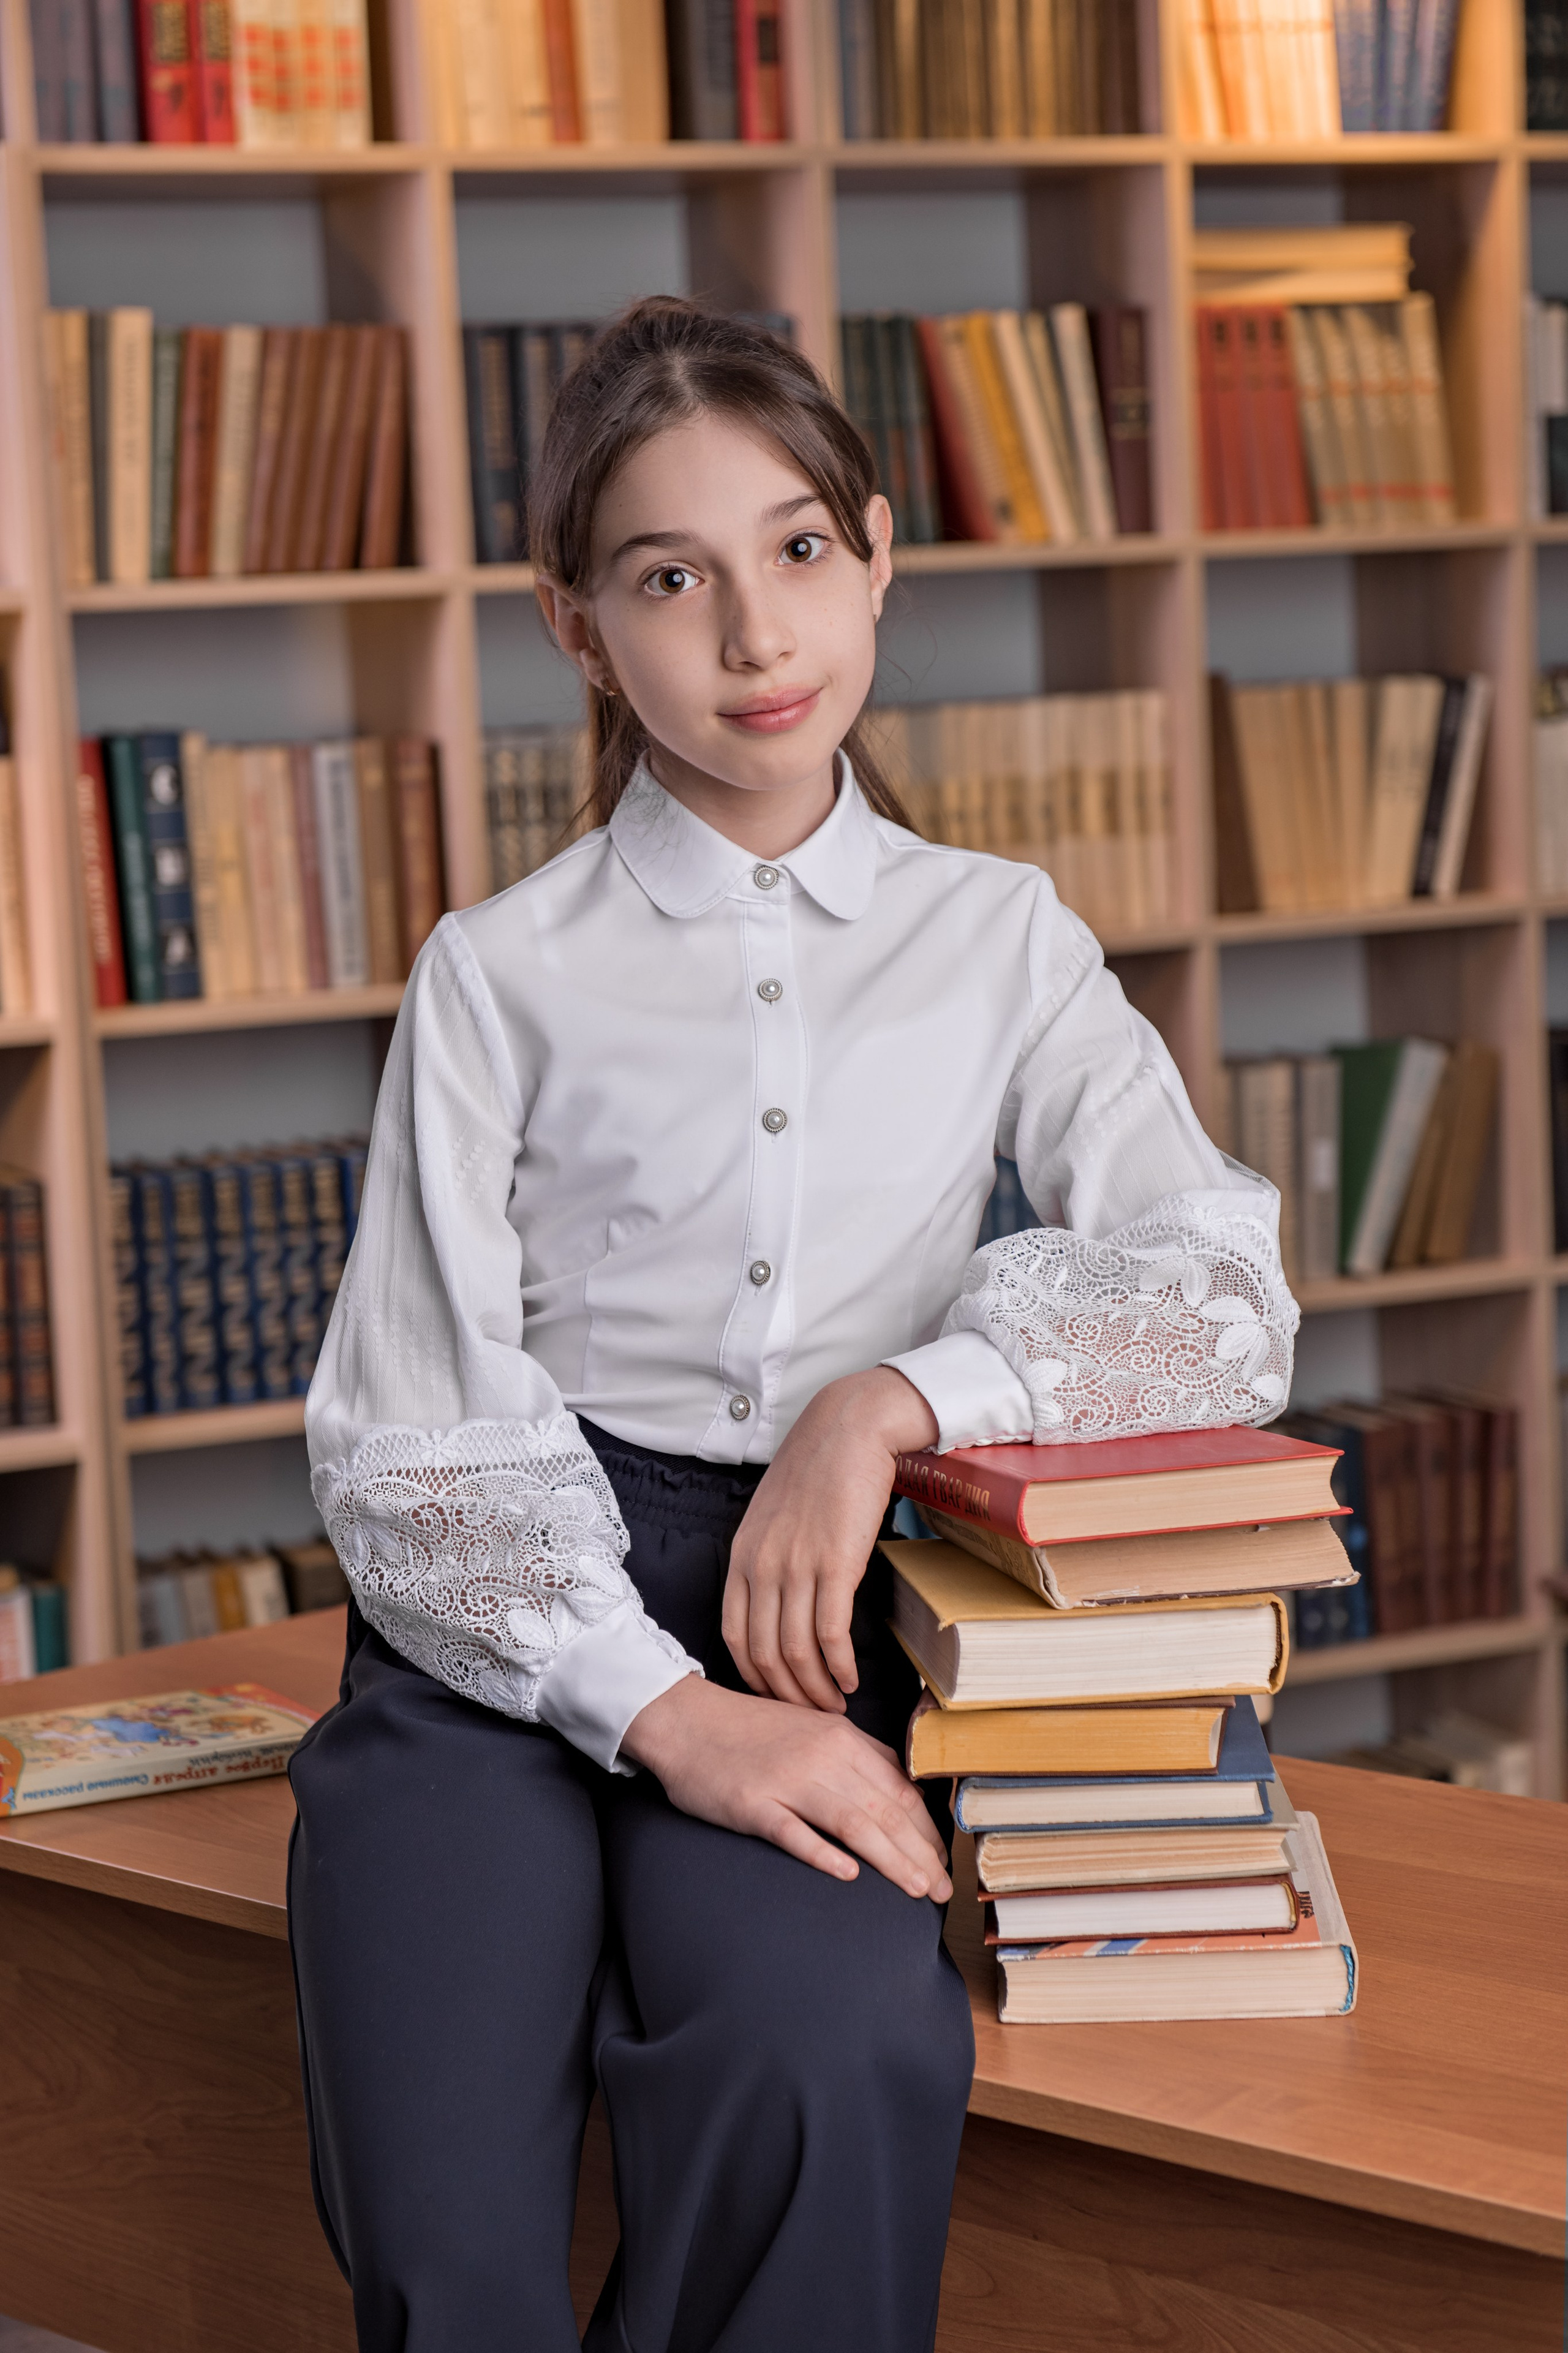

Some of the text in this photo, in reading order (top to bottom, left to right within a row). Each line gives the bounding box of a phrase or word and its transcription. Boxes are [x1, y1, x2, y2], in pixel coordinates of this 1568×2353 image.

[895, 1455, 929, 1497] ОДАЯ
[154, 1755, 285, 1785] Первое апреля
[23, 1773, 149, 1801] Смешные рассказы
